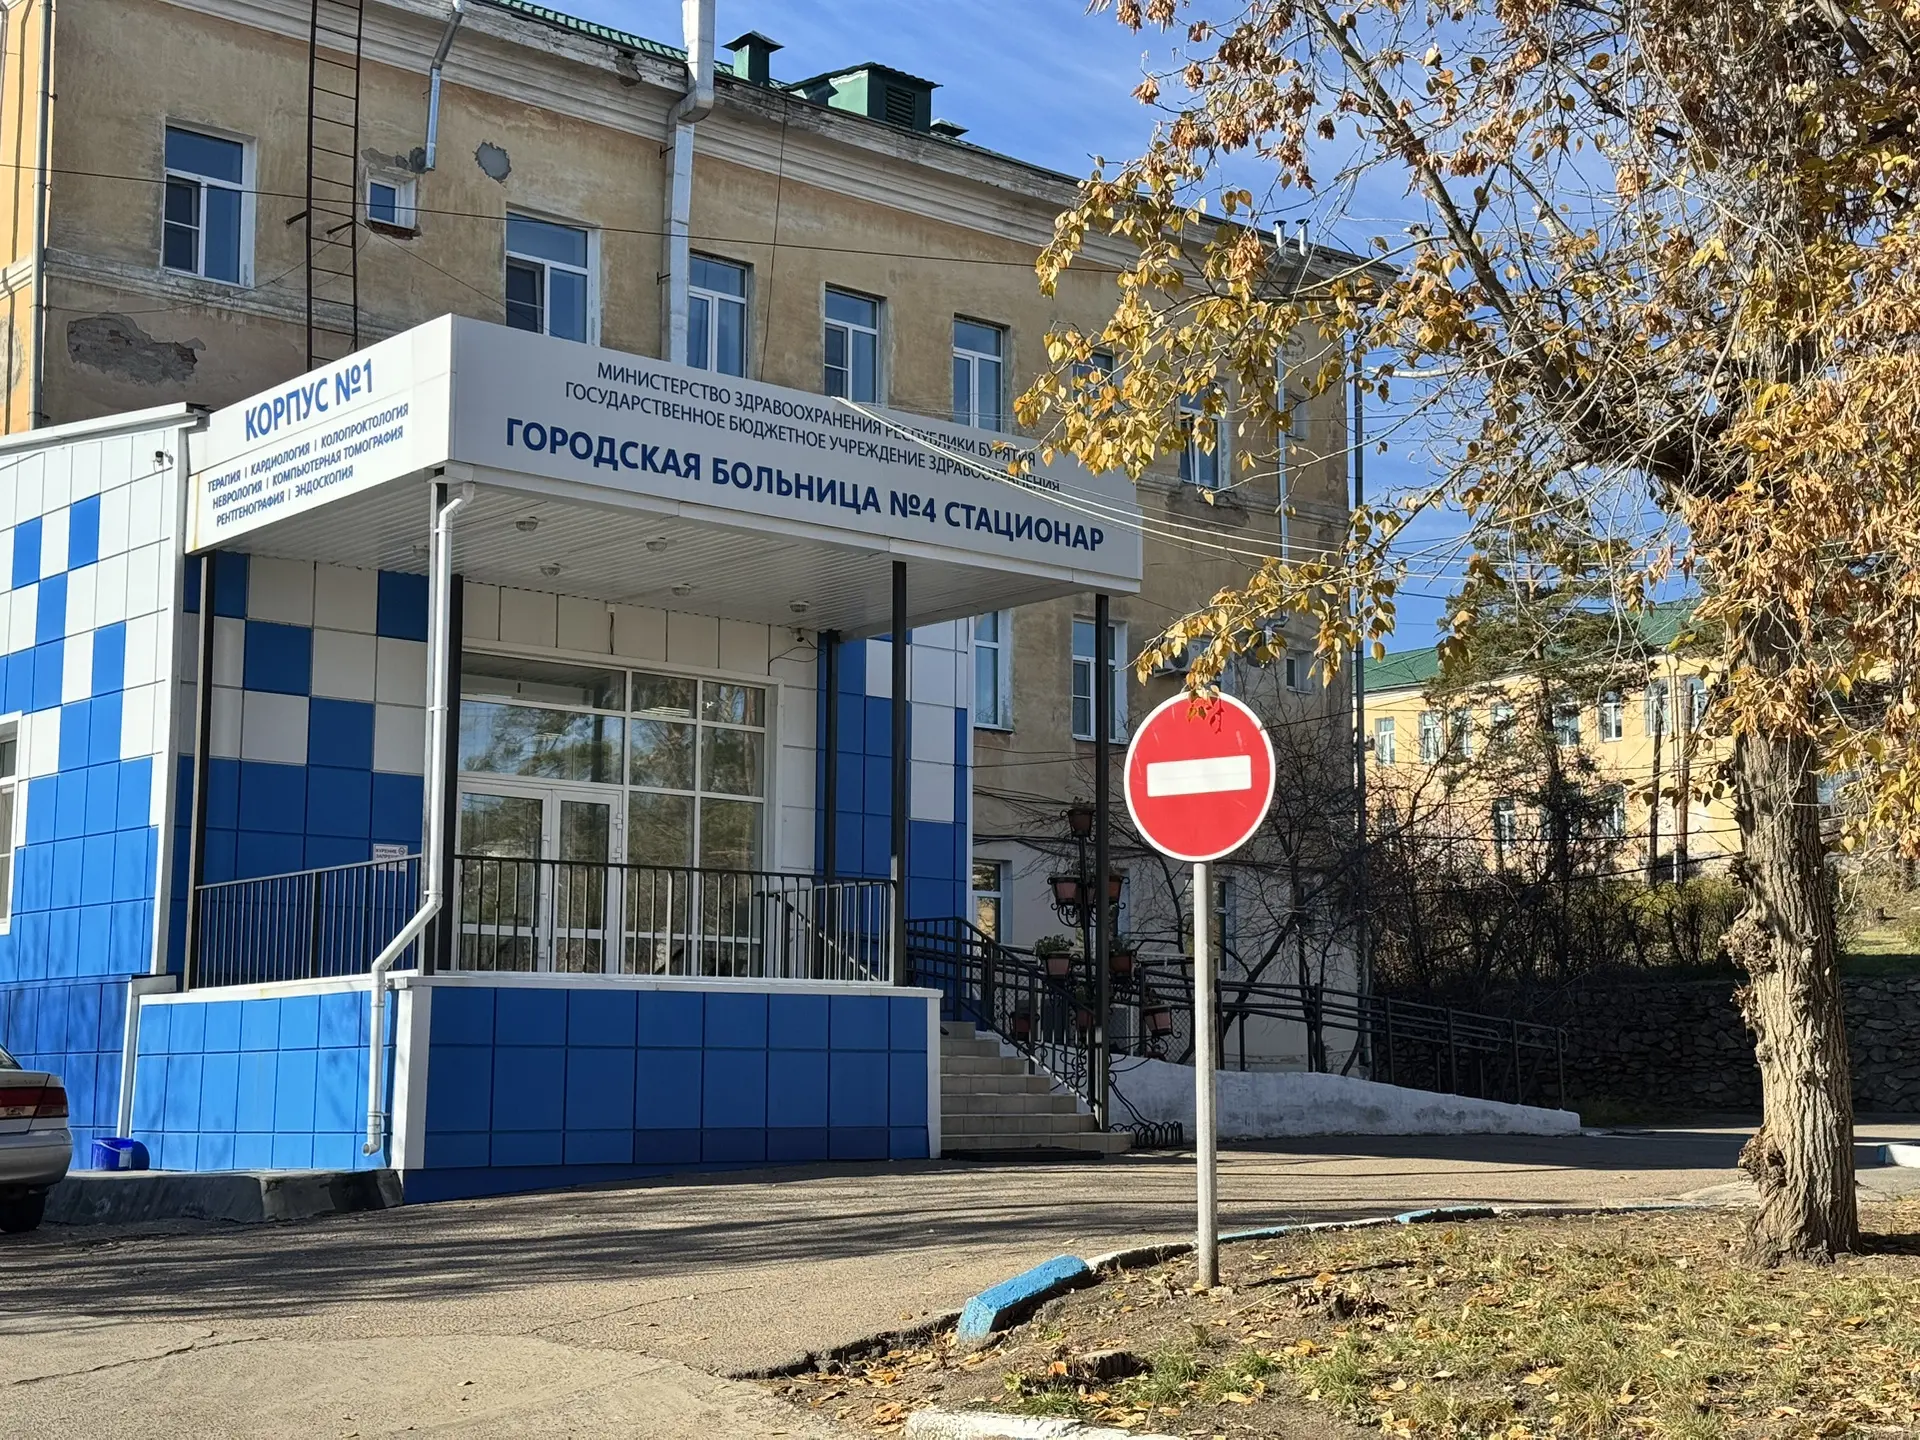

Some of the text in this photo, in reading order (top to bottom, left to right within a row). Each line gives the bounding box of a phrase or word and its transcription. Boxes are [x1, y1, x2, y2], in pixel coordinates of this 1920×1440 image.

[245, 358, 373, 441] КОРПУС №1
[565, 381, 725, 429] ГОСУДАРСТВЕННОЕ
[729, 415, 826, 449] БЮДЖЕТНОЕ
[829, 435, 926, 468] УЧРЕЖДЕНИЕ
[598, 362, 1036, 467] МИНИСТЕРСТВО ЗДРАВООХРАНЕНИЯ РЕСПУБЛИКИ БУРЯТИЯ
[207, 402, 409, 493] ТЕРАПИЯ КАРДИОЛОГИЯ КОЛОПРОКТОЛОГИЯ
[212, 425, 404, 510] НЕВРОЛОГИЯ КОМПЬЮТЕРНАЯ ТОМОГРАФИЯ
[506, 417, 1104, 551] ГОРОДСКАЯ БОЛЬНИЦА №4 СТАЦИОНАР
[216, 465, 354, 527] РЕНТГЕНОГРАФИЯ ЭНДОСКОПИЯ
